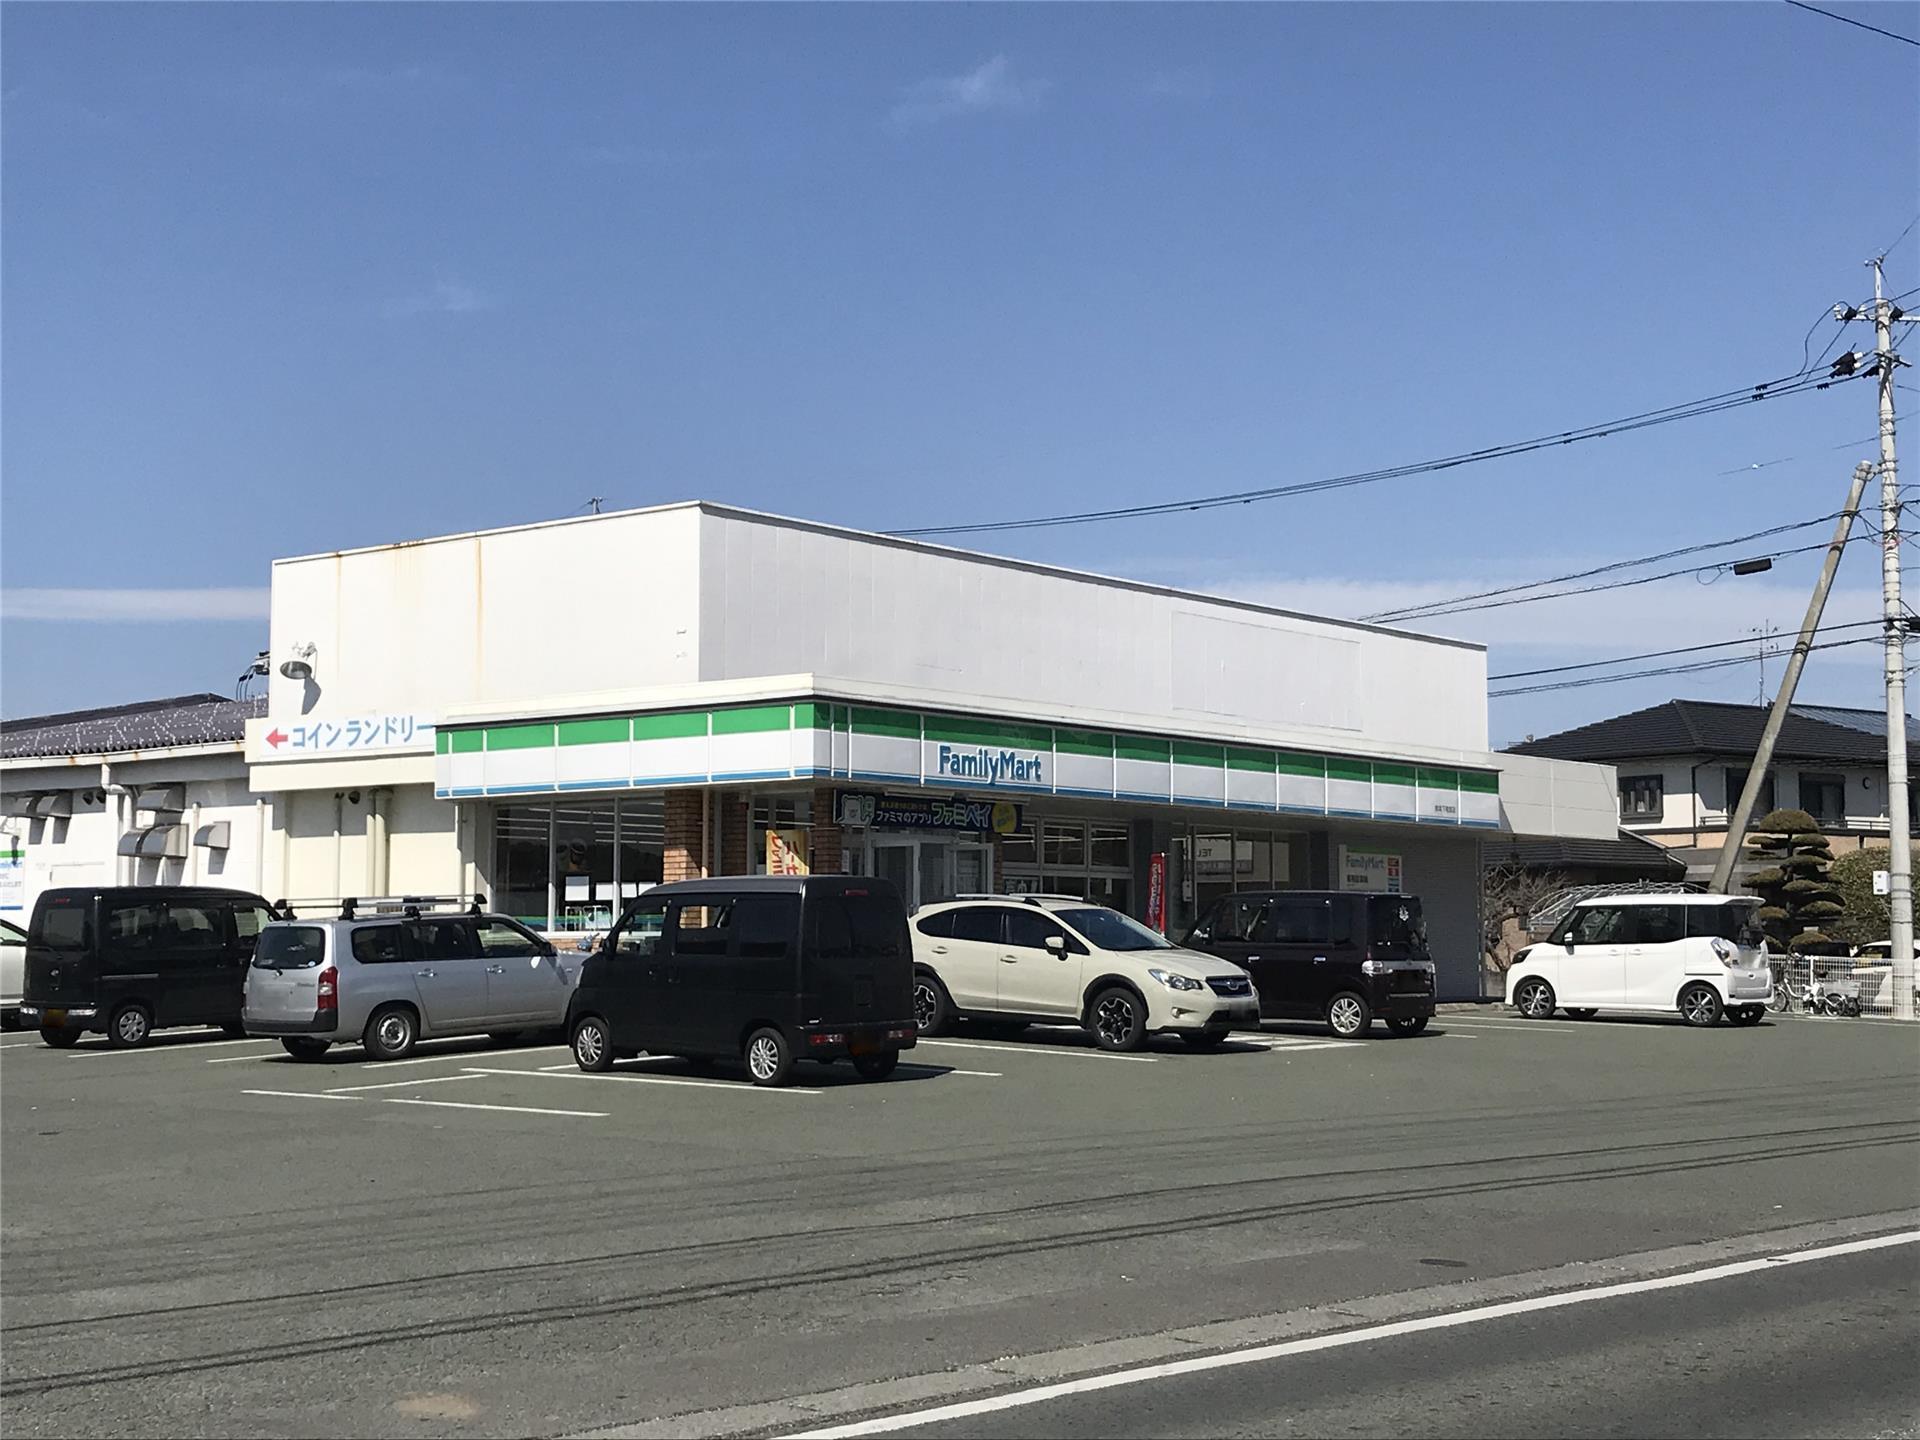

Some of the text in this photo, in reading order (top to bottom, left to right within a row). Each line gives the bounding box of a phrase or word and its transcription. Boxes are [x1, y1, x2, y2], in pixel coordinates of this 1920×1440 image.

[292, 715, 434, 750] コインランドリー
[938, 743, 1042, 786] FamilyMart
[876, 810, 932, 824] ファミマのアプリ
[931, 802, 992, 828] ファミペイ
